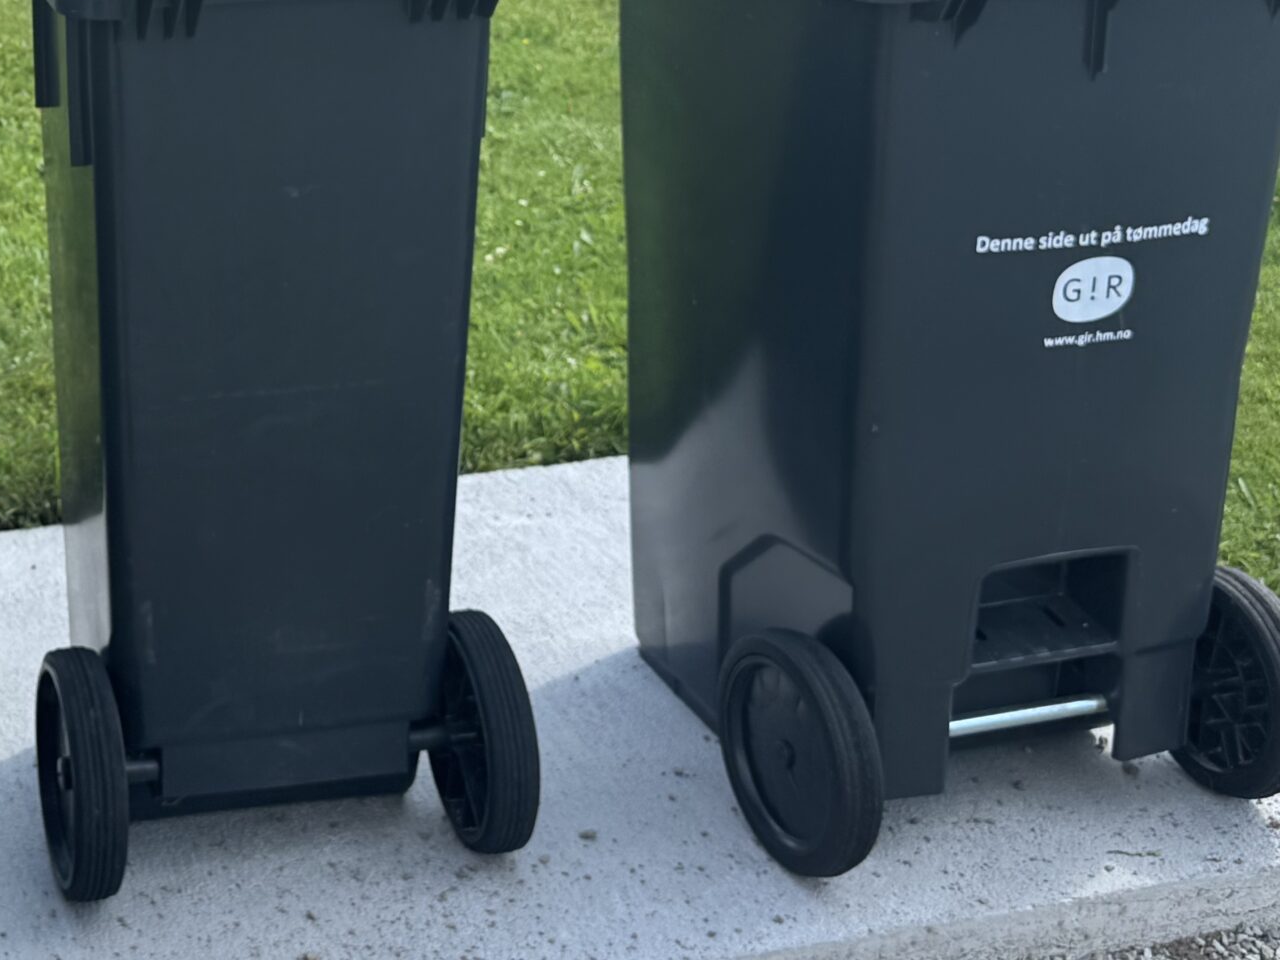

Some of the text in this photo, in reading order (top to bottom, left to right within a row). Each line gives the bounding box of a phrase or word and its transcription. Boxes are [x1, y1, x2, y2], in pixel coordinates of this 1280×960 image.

[975, 216, 1210, 253] Denne side ut på tømmedag
[1043, 328, 1133, 348] www.gir.hm.no
